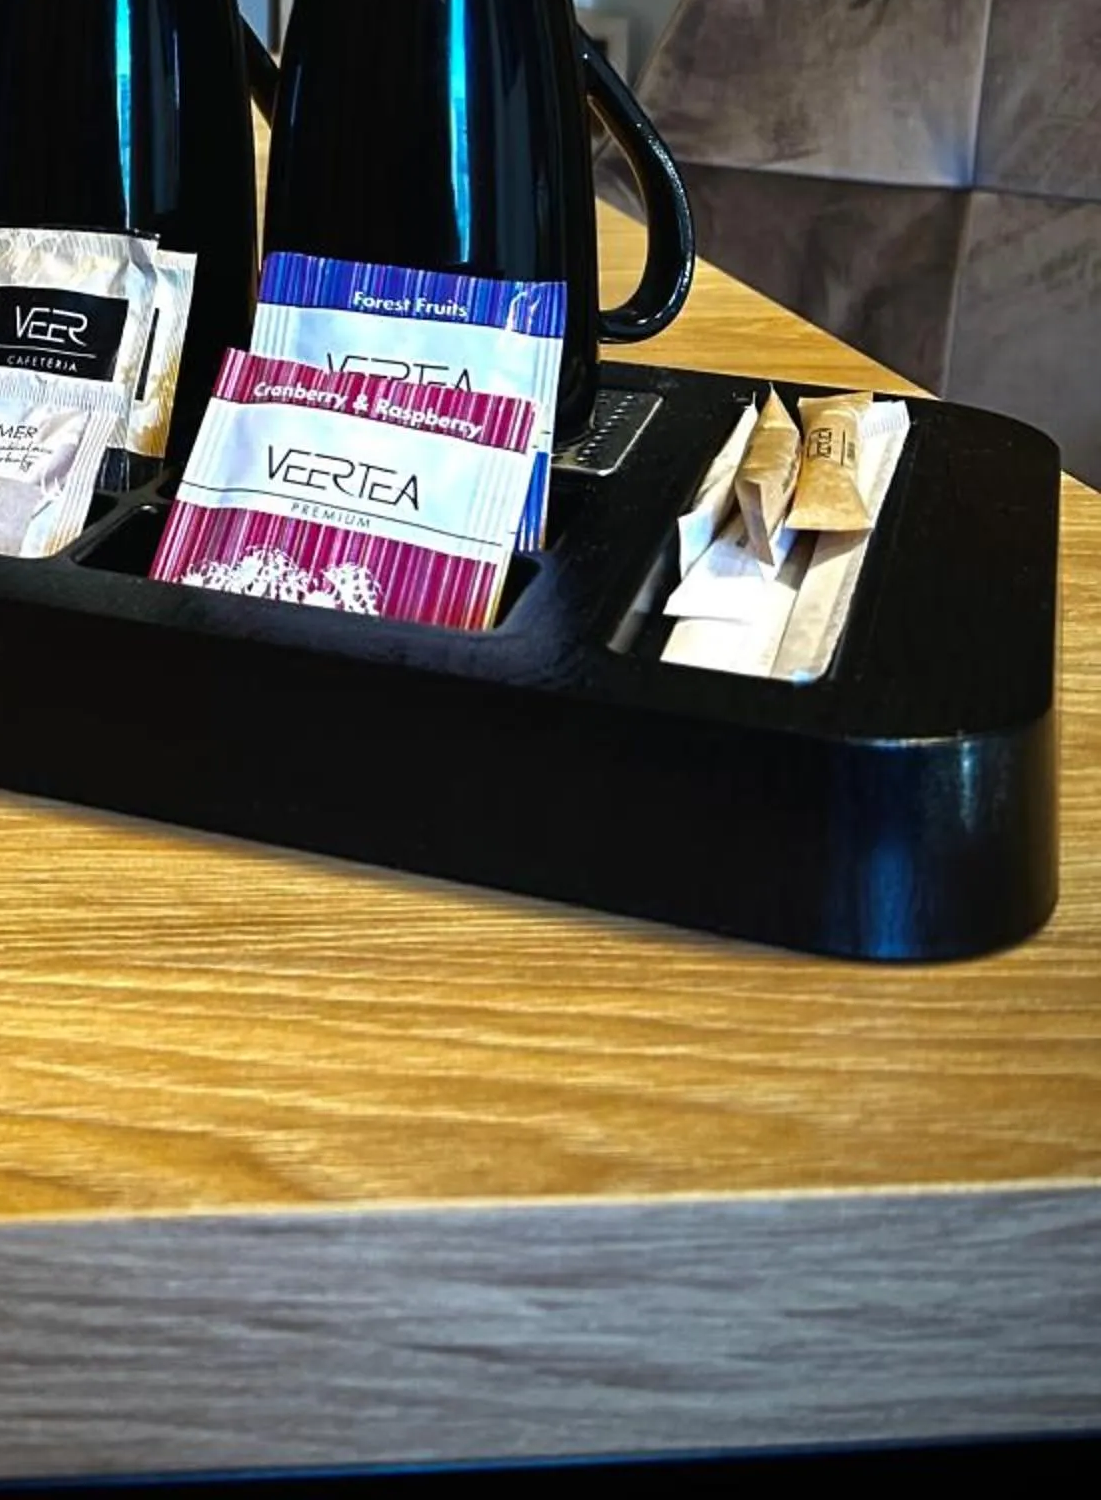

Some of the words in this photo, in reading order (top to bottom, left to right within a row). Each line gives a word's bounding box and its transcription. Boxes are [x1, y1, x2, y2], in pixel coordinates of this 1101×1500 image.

[354, 291, 410, 312] Forest
[416, 297, 467, 317] Fruits
[15, 305, 89, 347] VEER
[6, 355, 78, 373] CAFETERIA
[254, 382, 348, 410] Cranberry
[352, 394, 369, 412] &
[376, 400, 483, 438] Raspberry
[268, 444, 420, 512] VEERTEA
[290, 502, 371, 529] PREMIUM
